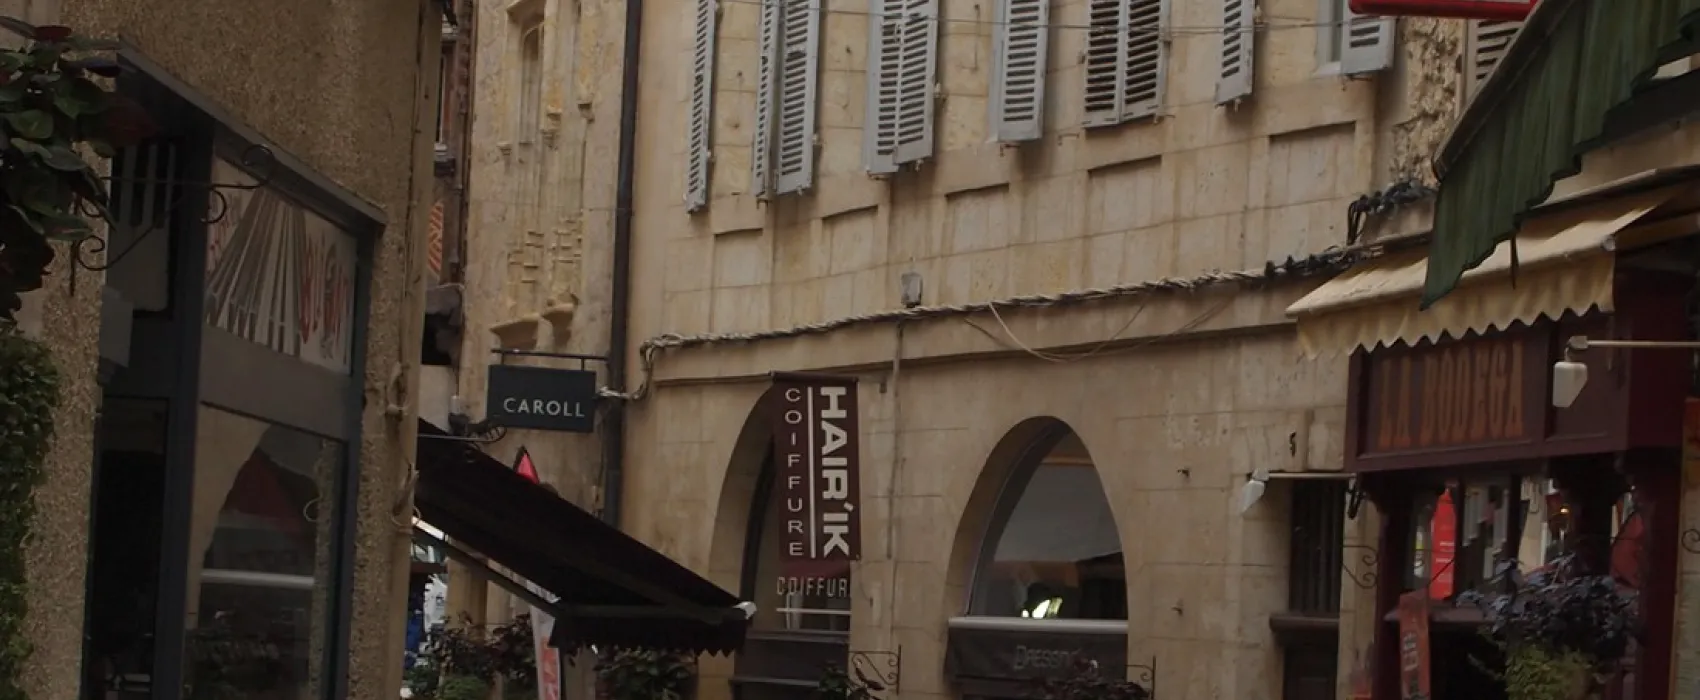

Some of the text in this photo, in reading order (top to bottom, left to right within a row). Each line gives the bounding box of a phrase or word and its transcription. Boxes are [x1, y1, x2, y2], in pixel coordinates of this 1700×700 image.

[502, 397, 585, 418] CAROLL
[1378, 341, 1523, 449] LA BODEGA
[784, 387, 804, 557] COIFFURE
[819, 385, 854, 559] HAIR'IK
[776, 576, 849, 599] COIFFUR
